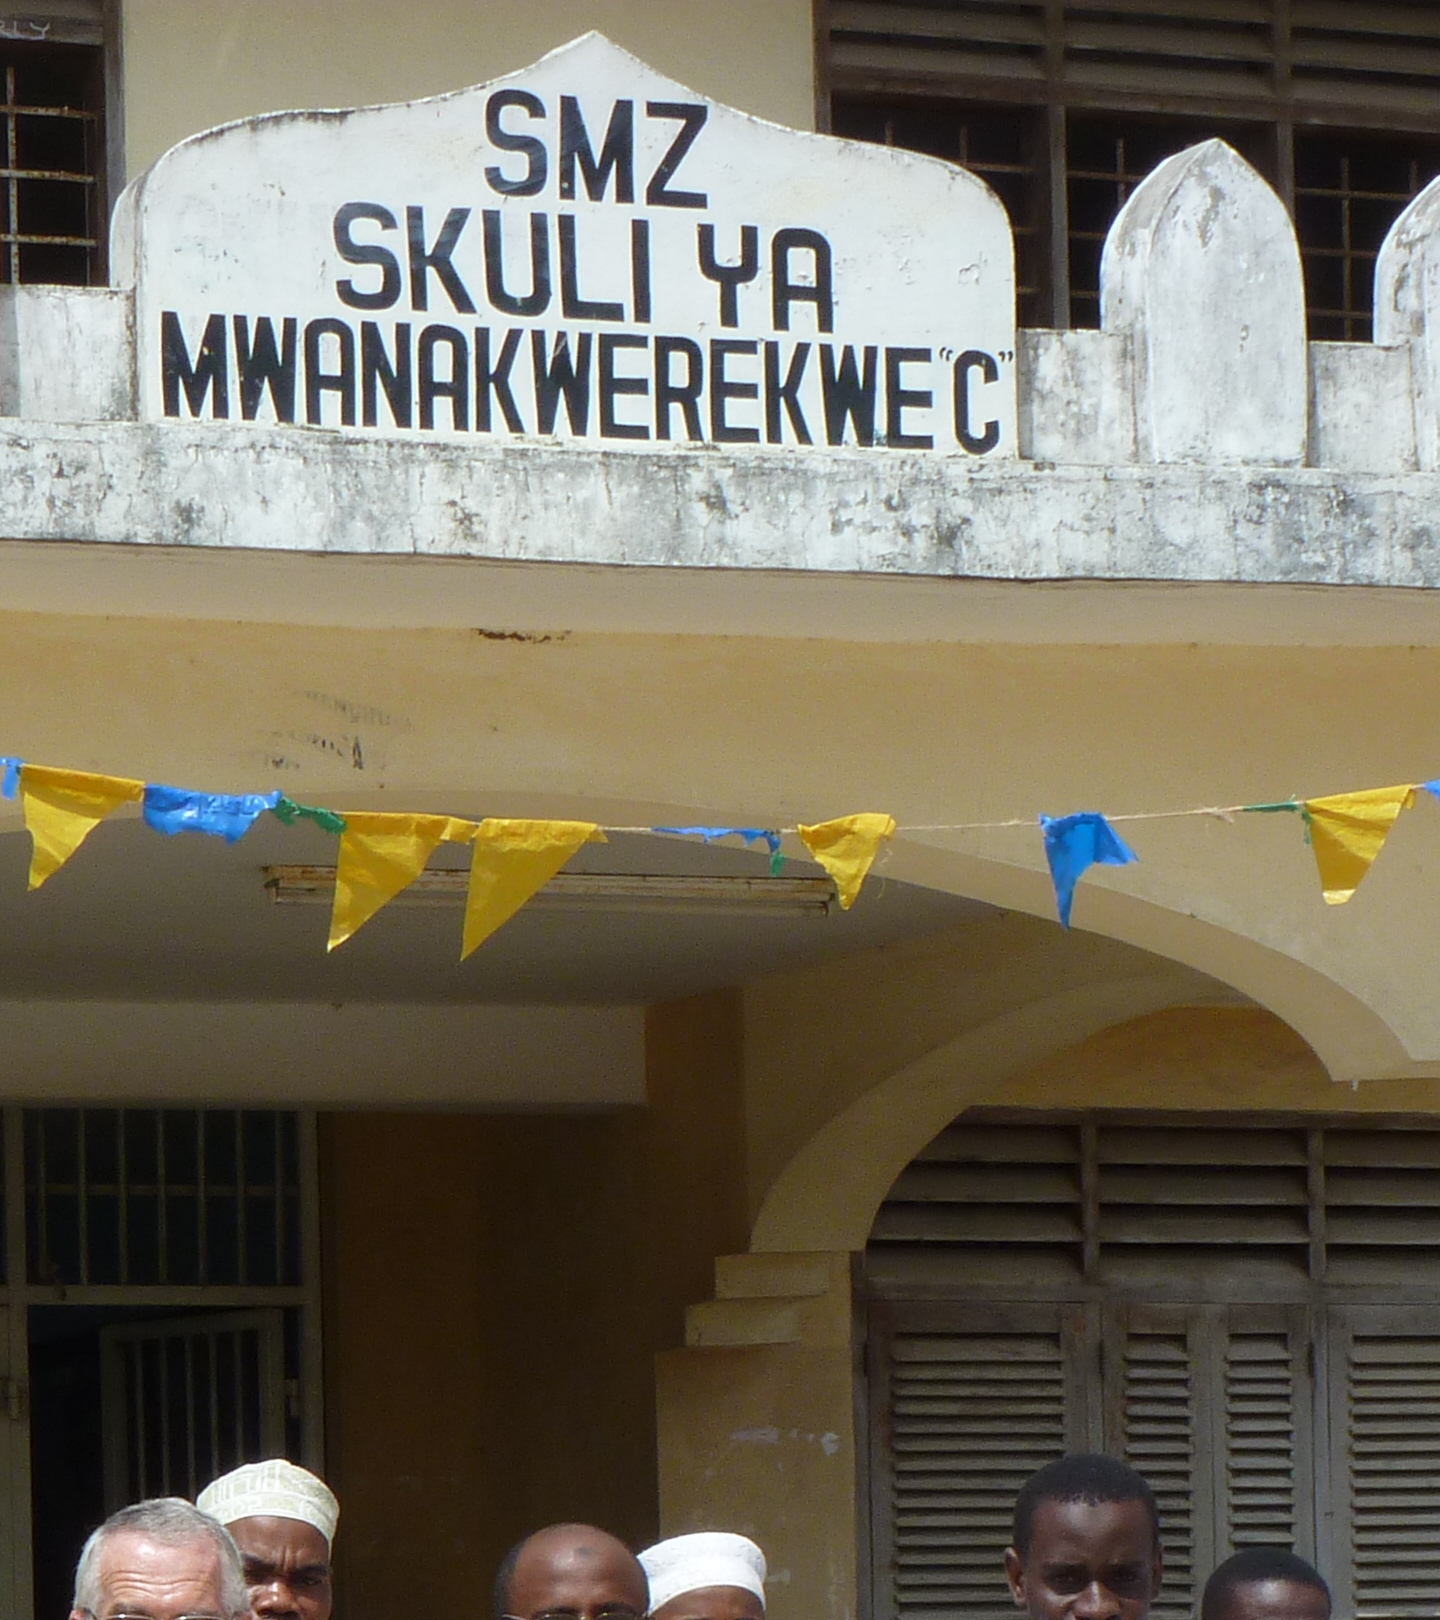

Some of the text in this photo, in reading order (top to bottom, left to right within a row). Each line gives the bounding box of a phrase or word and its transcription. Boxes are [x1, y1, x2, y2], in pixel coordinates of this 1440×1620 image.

[484, 90, 708, 210] SMZ
[334, 203, 834, 333] SKULI YA
[160, 312, 935, 451] MWANAKWEREKWE
